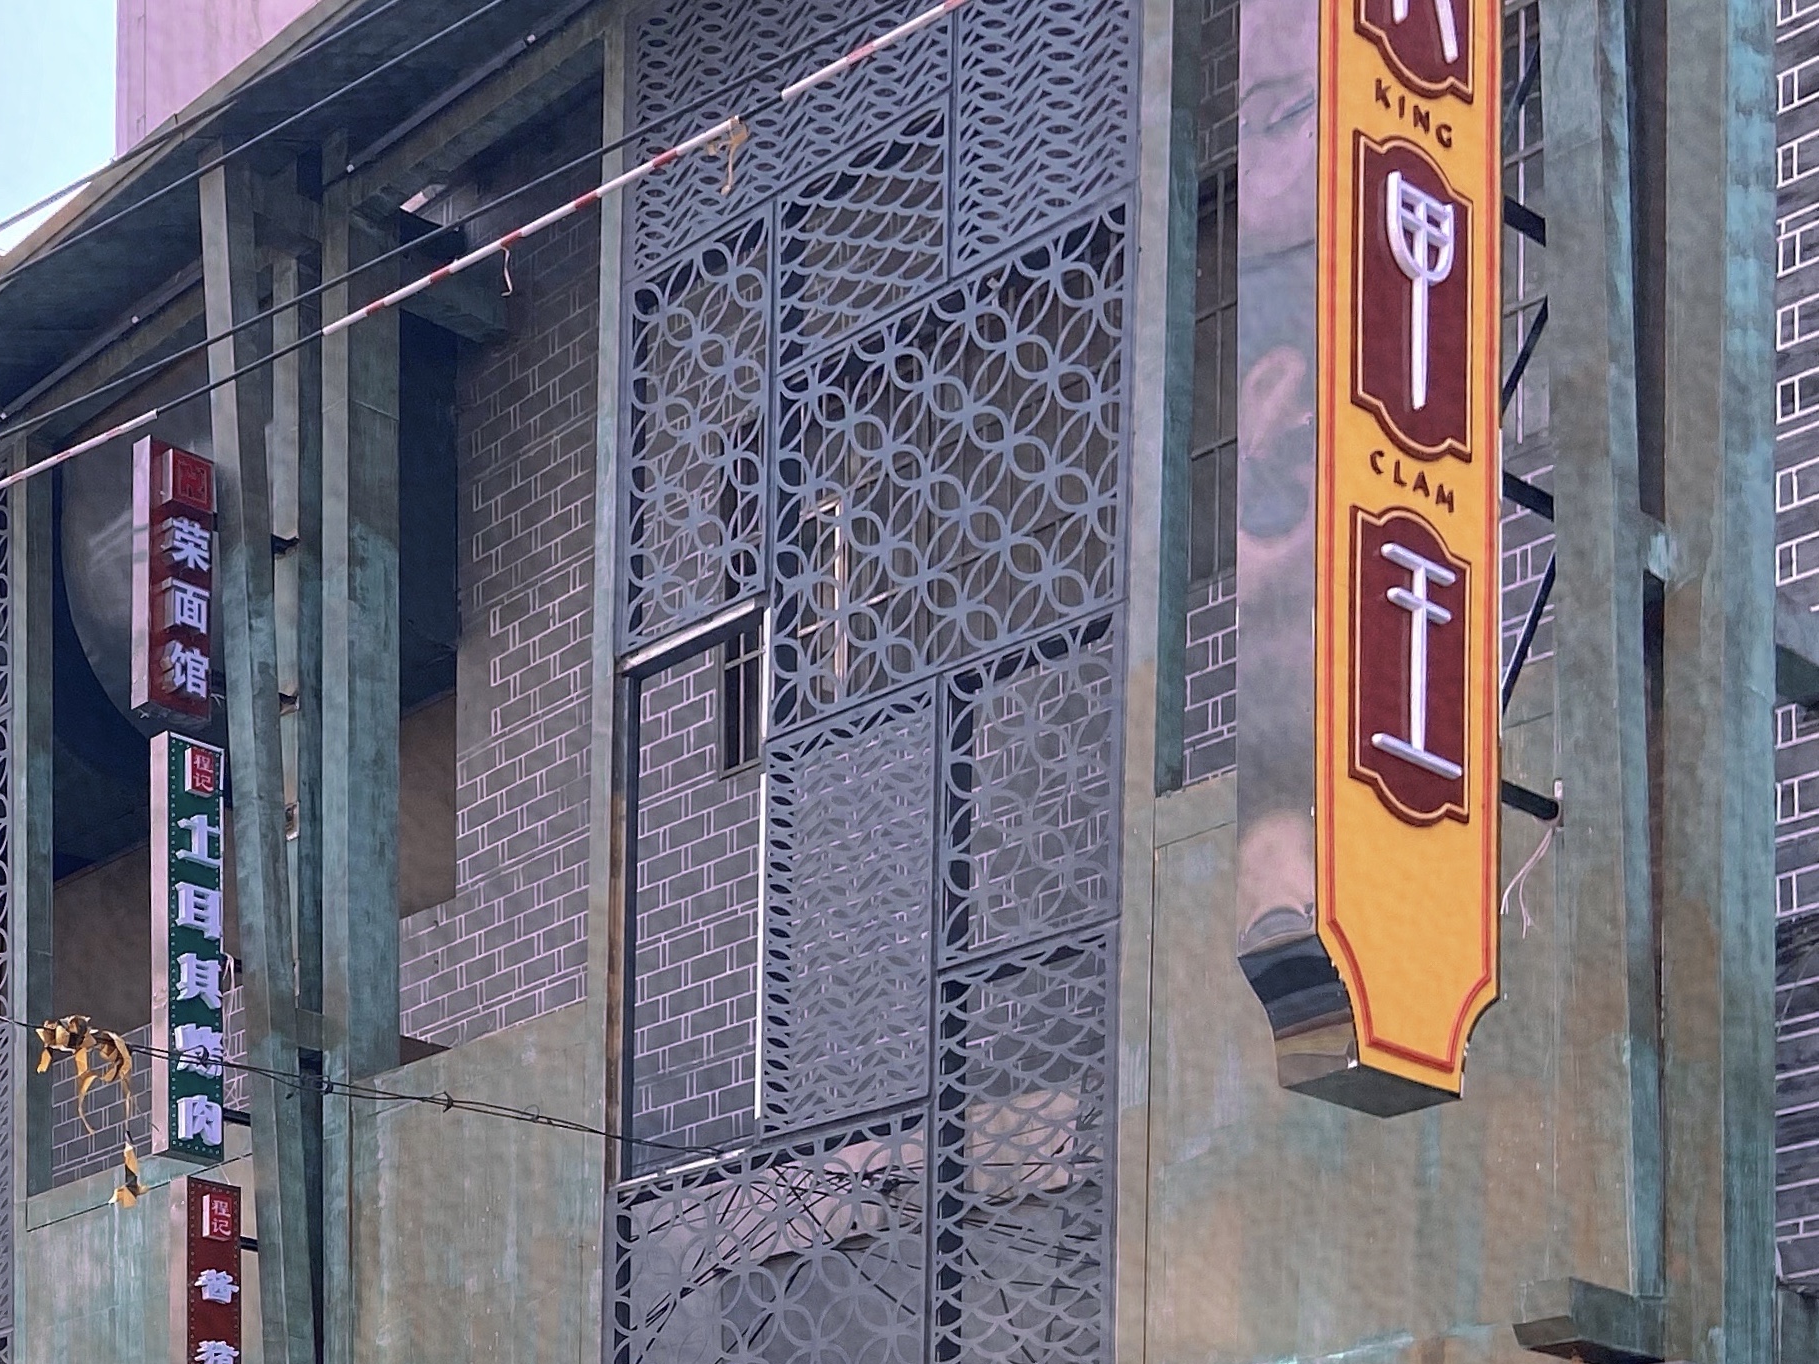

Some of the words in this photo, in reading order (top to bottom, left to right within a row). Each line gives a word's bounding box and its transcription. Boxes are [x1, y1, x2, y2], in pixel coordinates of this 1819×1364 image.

[1375, 78, 1453, 148] KING
[1370, 449, 1455, 513] CLAM
[169, 516, 211, 699] 荣面馆
